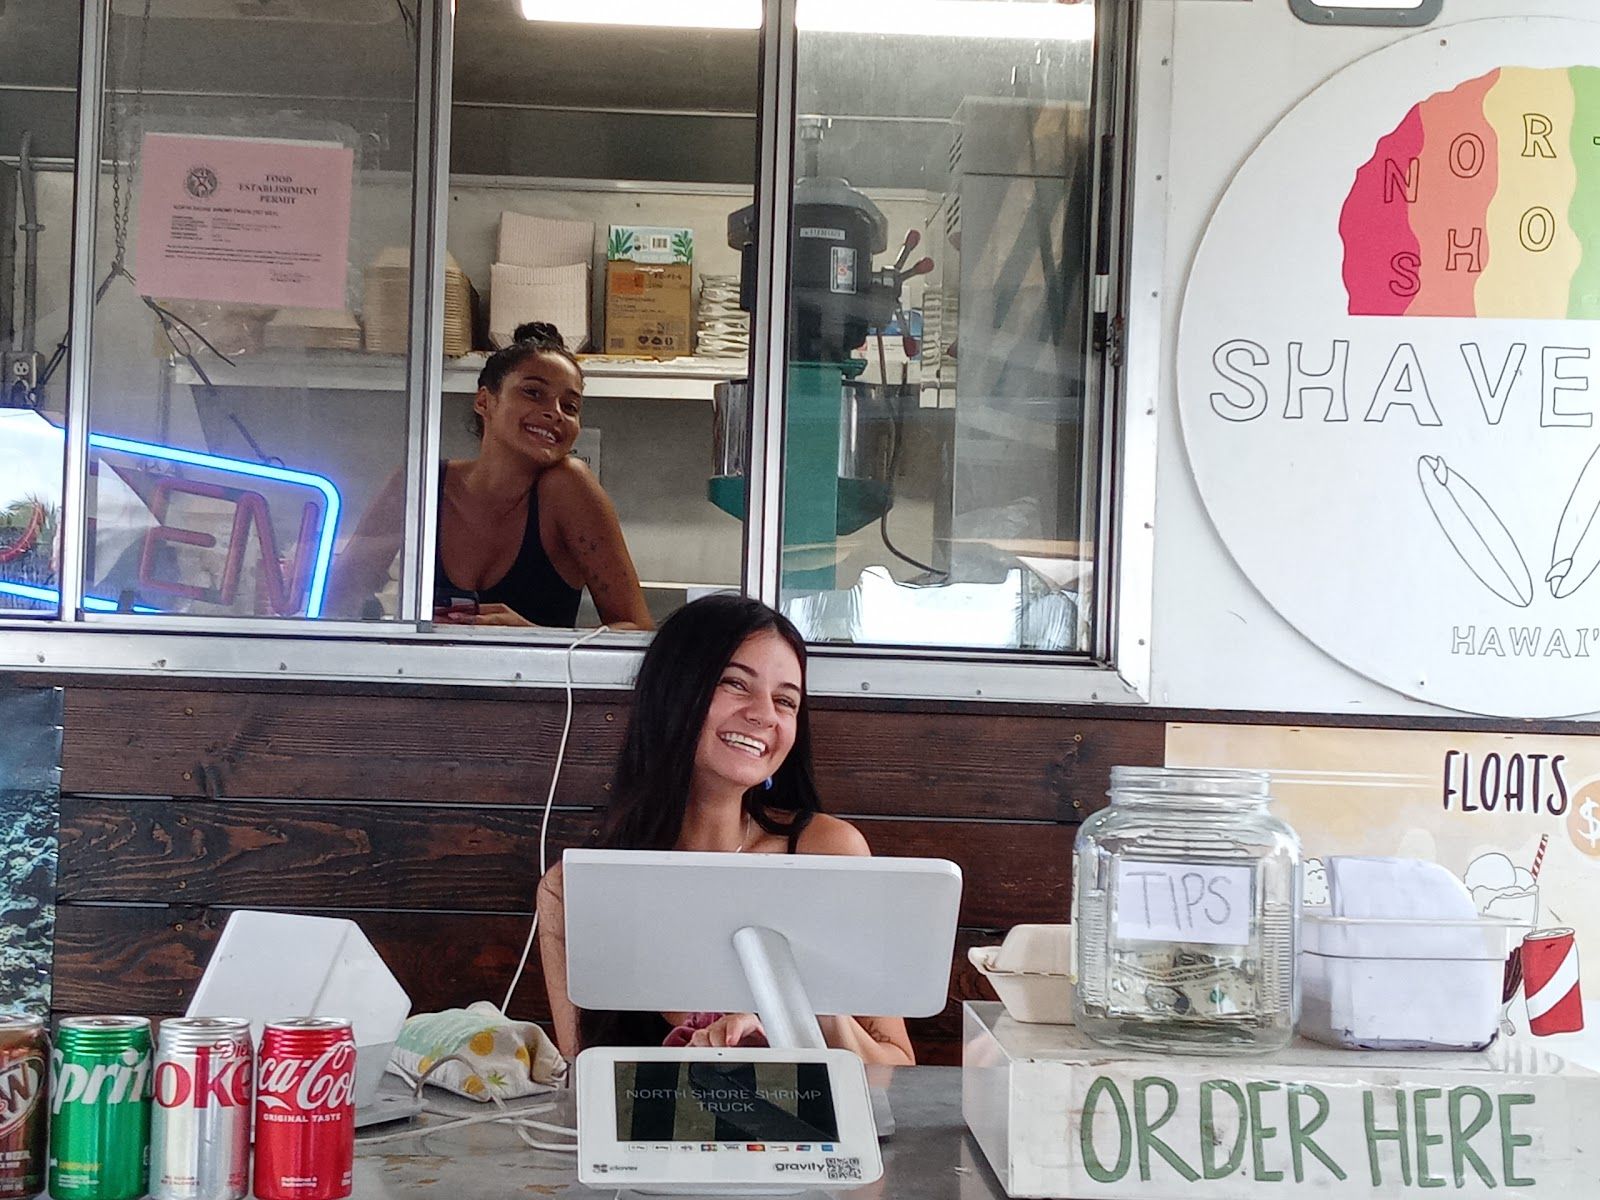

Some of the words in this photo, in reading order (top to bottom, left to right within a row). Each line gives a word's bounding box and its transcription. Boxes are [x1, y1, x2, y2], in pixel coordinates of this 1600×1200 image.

[1384, 113, 1600, 204] NOR
[264, 174, 293, 183] FOOD
[238, 184, 318, 196] ESTABLISHMENT
[260, 195, 296, 205] PERMIT
[1210, 339, 1594, 428] SHAVE
[1442, 749, 1569, 816] FLOATS
[1125, 871, 1233, 931] TIPS
[626, 1088, 687, 1100] NORTH
[691, 1088, 750, 1100] SHORE
[754, 1088, 822, 1101] SHRIMP
[698, 1101, 754, 1113] TRUCK
[263, 1113, 309, 1123] ORIGINAL
[311, 1113, 342, 1123] TASTE
[1079, 1075, 1347, 1183] ORDER
[1362, 1085, 1537, 1190] HERE
[775, 1162, 826, 1173] gravity
